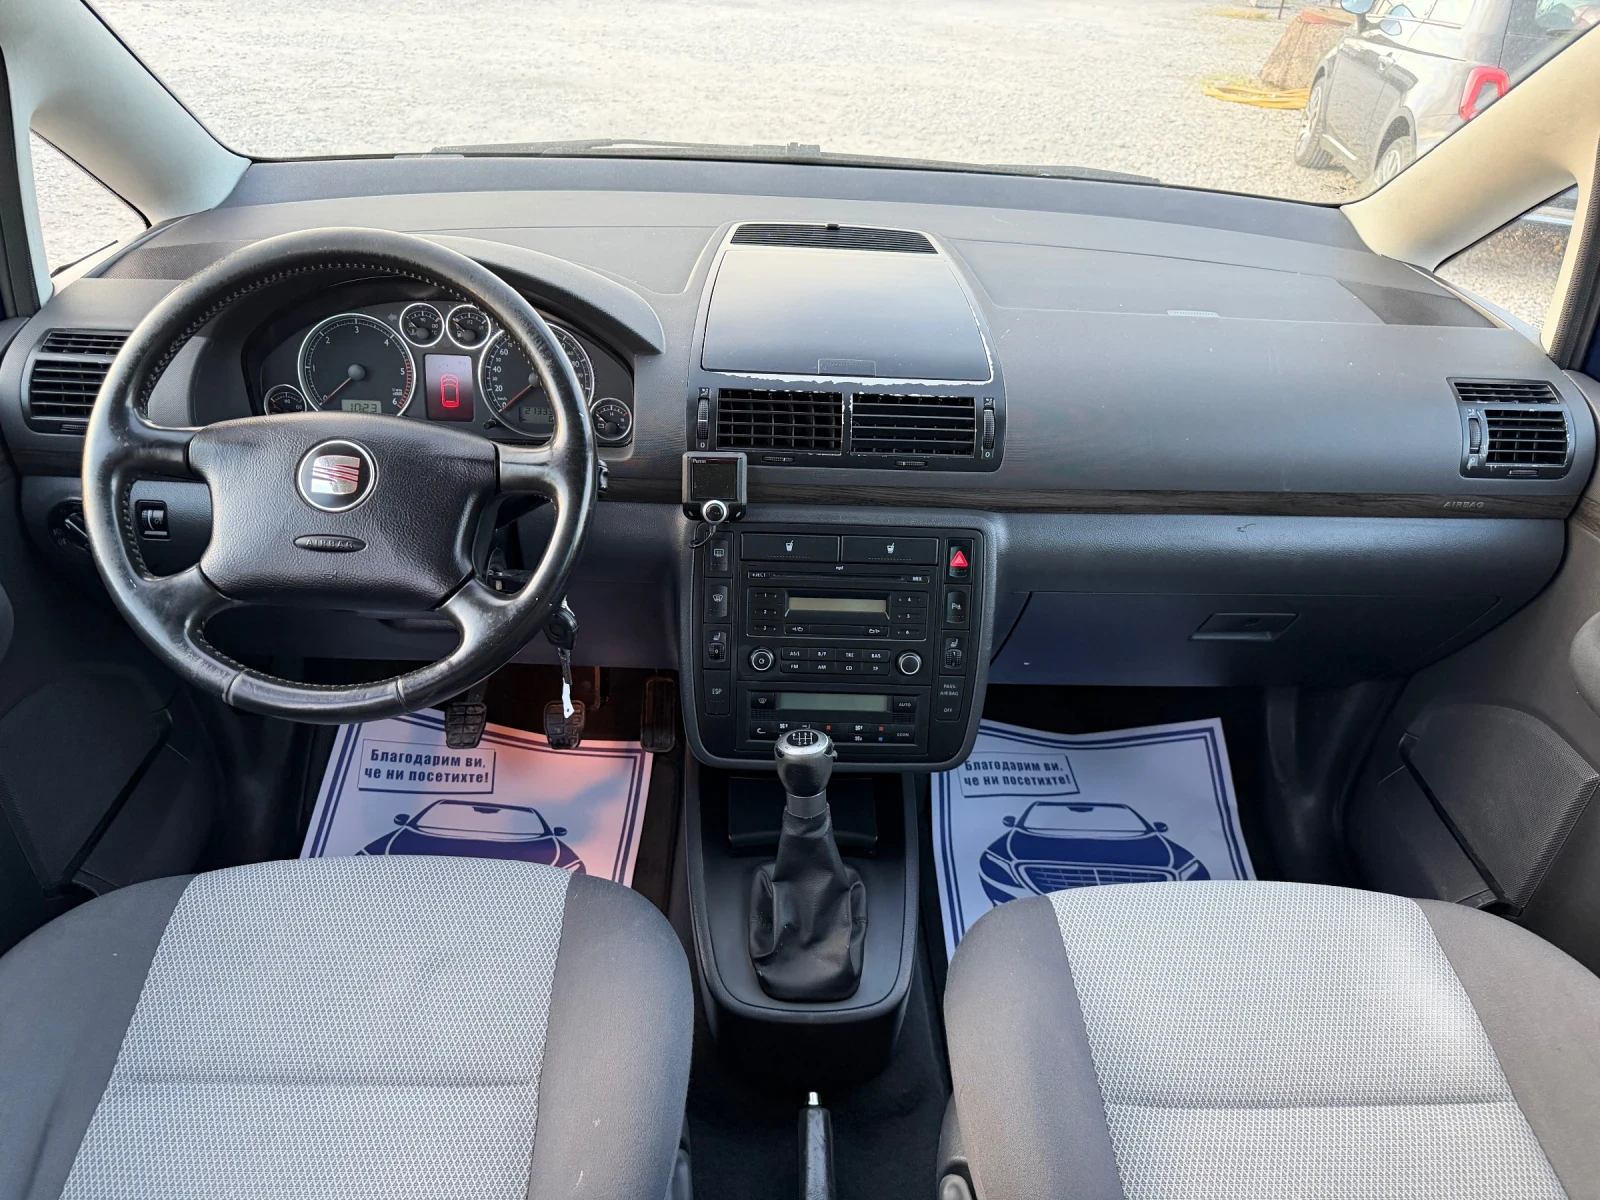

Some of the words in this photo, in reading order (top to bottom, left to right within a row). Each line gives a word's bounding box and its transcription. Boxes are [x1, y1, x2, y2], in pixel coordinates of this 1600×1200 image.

[350, 403, 378, 413] 10:23
[306, 539, 354, 549] AIRBAG
[370, 748, 461, 767] Благодарим
[465, 757, 486, 768] ви,
[964, 760, 1041, 771] Благодарим
[364, 767, 381, 779] че
[386, 768, 404, 780] ни
[408, 770, 489, 783] посетихте!
[963, 776, 979, 786] че
[983, 775, 999, 786] ни
[1002, 774, 1071, 786] посетихте!
